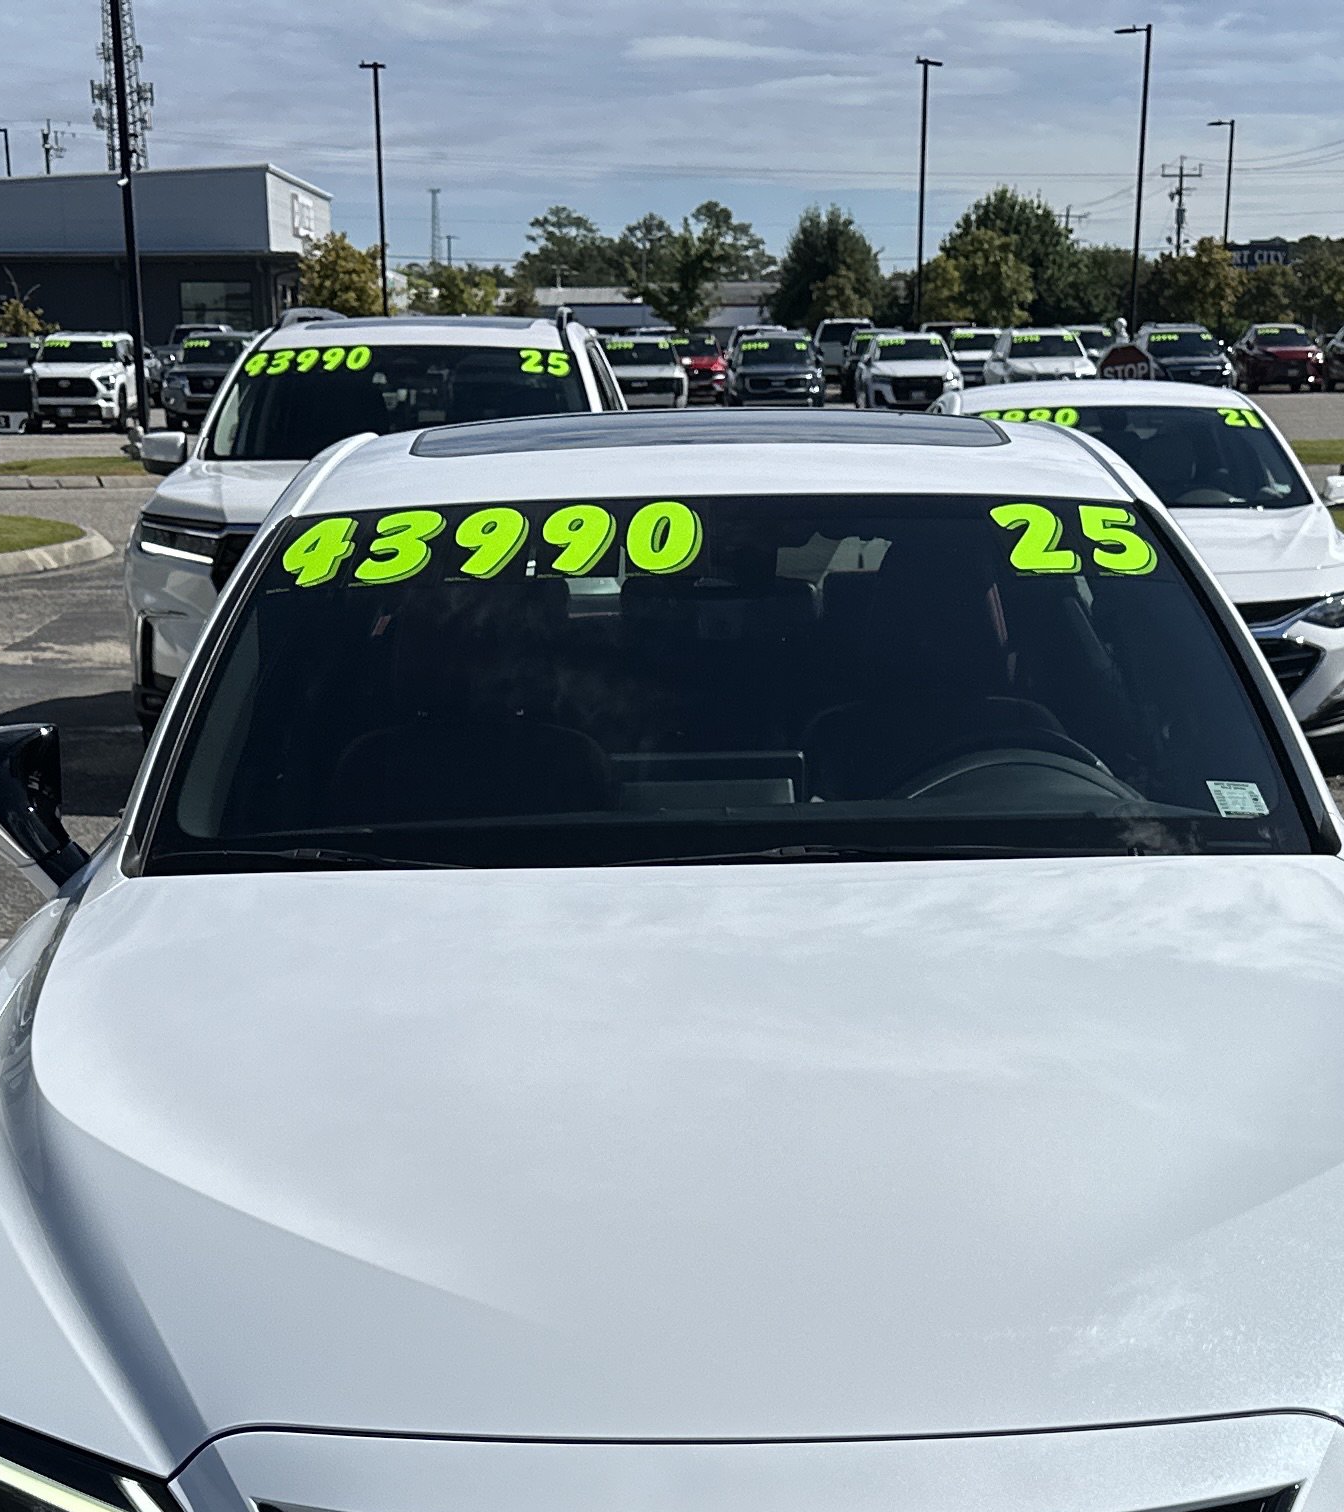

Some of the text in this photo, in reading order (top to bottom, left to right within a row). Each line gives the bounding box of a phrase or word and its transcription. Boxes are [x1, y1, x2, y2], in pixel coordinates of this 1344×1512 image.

[244, 345, 572, 378] 43990 25
[1103, 362, 1149, 379] STOP
[1216, 407, 1264, 429] 21
[282, 501, 1158, 587] 43990 25
